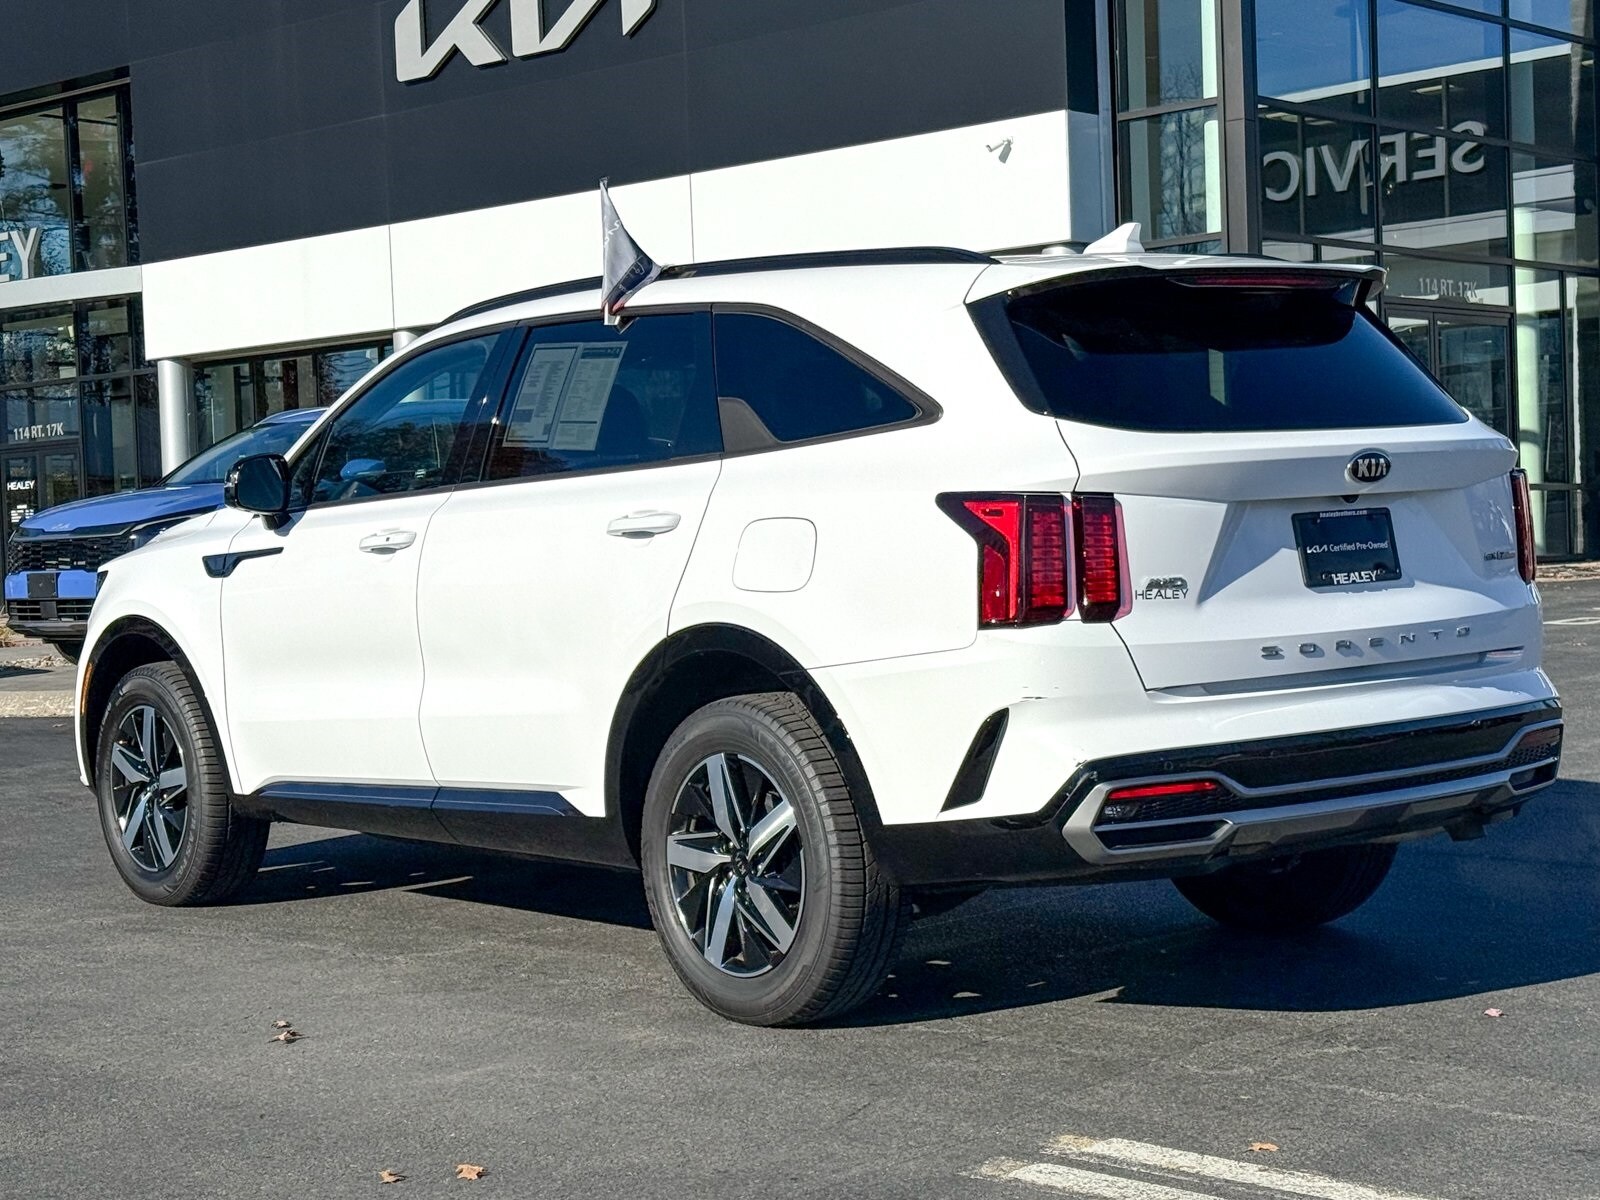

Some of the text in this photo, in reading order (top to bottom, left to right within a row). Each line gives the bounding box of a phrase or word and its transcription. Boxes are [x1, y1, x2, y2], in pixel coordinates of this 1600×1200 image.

[1419, 278, 1439, 294] 114
[1440, 279, 1456, 297] RT.
[13, 421, 65, 441] 114 RT. 17K
[1357, 458, 1387, 478] KIA
[6, 479, 36, 491] HEALEY
[1306, 541, 1388, 554] KIA Certified Pre-Owned
[1332, 569, 1377, 584] HEALEY
[1135, 588, 1189, 600] HEALEY
[1261, 626, 1471, 658] SORENTO
